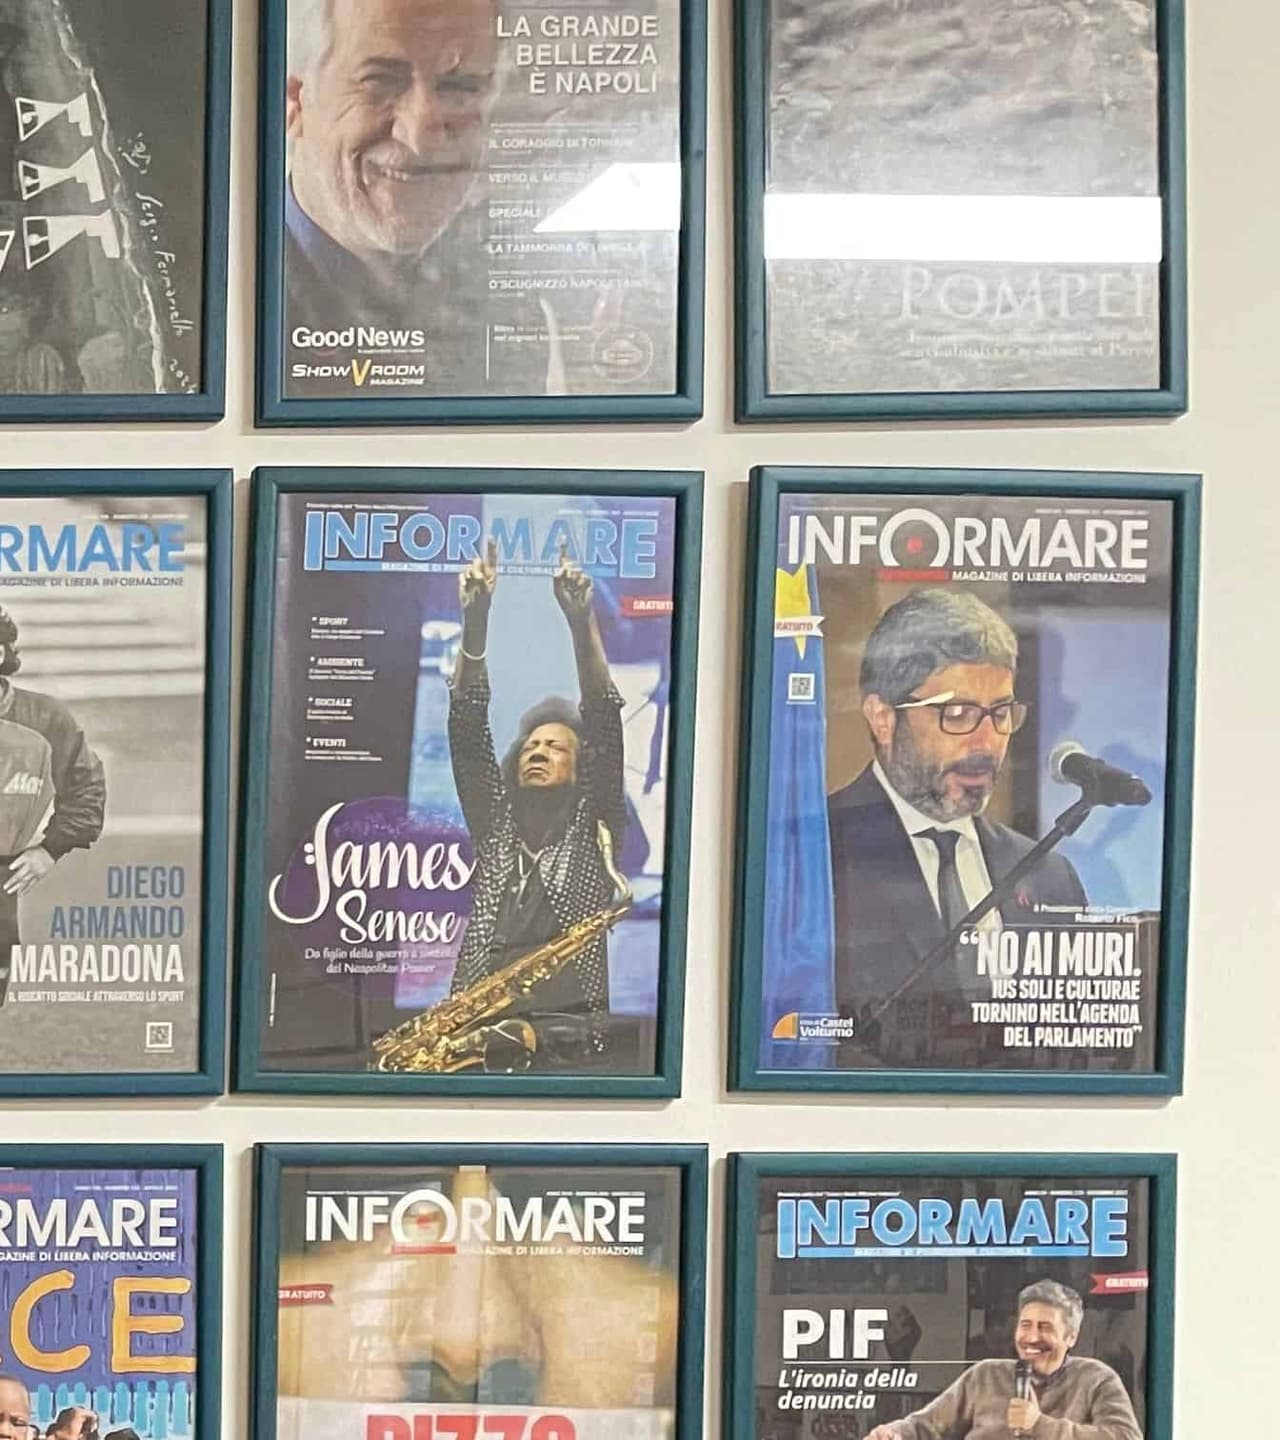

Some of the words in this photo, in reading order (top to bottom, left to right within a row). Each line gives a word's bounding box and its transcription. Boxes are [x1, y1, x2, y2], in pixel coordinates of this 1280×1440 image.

[497, 17, 531, 38] LA
[540, 15, 658, 38] GRANDE
[517, 43, 657, 66] BELLEZZA
[530, 70, 546, 94] È
[556, 72, 657, 94] NAPOLI
[303, 511, 658, 578] INFORMARE
[789, 508, 1149, 569] INFORMARE
[269, 802, 477, 925] James
[107, 865, 185, 899] DIEGO
[50, 905, 185, 939] ARMANDO
[339, 889, 461, 945] Senese
[9, 943, 185, 984] MARADONA
[1023, 931, 1054, 976] AI
[1058, 931, 1142, 977] MURI.
[991, 979, 1017, 1000] IUS
[1019, 979, 1053, 1000] SOLI
[1055, 980, 1065, 1000] E
[1066, 980, 1141, 1001] CULTURAE
[971, 1002, 1038, 1024] TORNINO
[1039, 1001, 1140, 1025] NELL'AGENDA
[1003, 1026, 1033, 1048] DEL
[305, 1189, 646, 1243] INFORMARE
[776, 1197, 1128, 1260] INFORMARE
[39, 1251, 51, 1263] DI
[54, 1251, 90, 1263] LIBERA
[93, 1252, 177, 1263] INFORMAZIONE
[781, 1308, 890, 1361] PIF
[778, 1368, 860, 1389] L'ironia
[863, 1368, 917, 1389] della
[777, 1390, 876, 1411] denuncia
